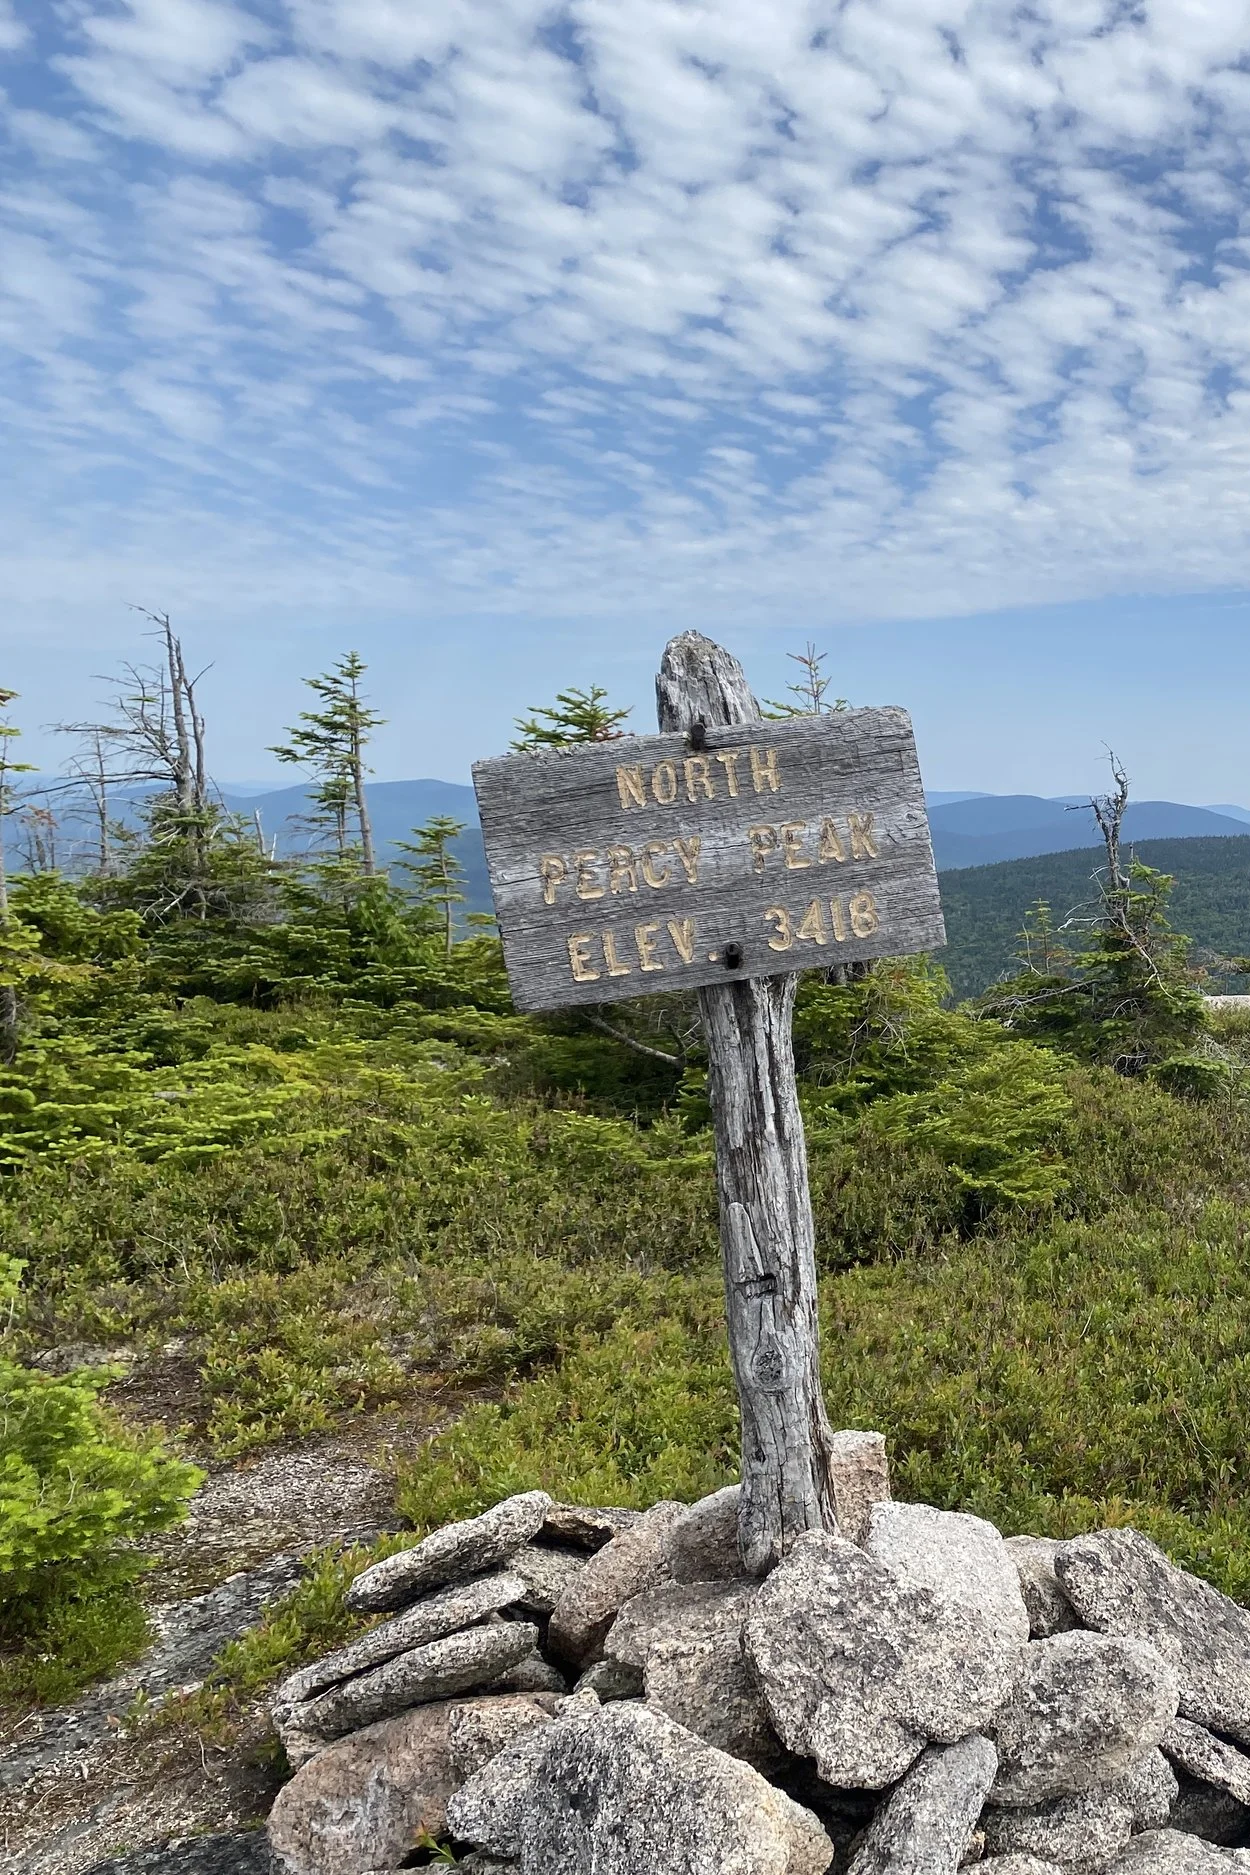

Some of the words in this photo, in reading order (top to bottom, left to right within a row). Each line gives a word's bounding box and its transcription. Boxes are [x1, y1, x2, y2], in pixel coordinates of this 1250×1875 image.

[615, 747, 783, 809] NORTH
[539, 835, 701, 905] PERCY
[748, 812, 880, 874] PEAK
[567, 917, 718, 982] ELEV.
[764, 890, 880, 952] 3418
